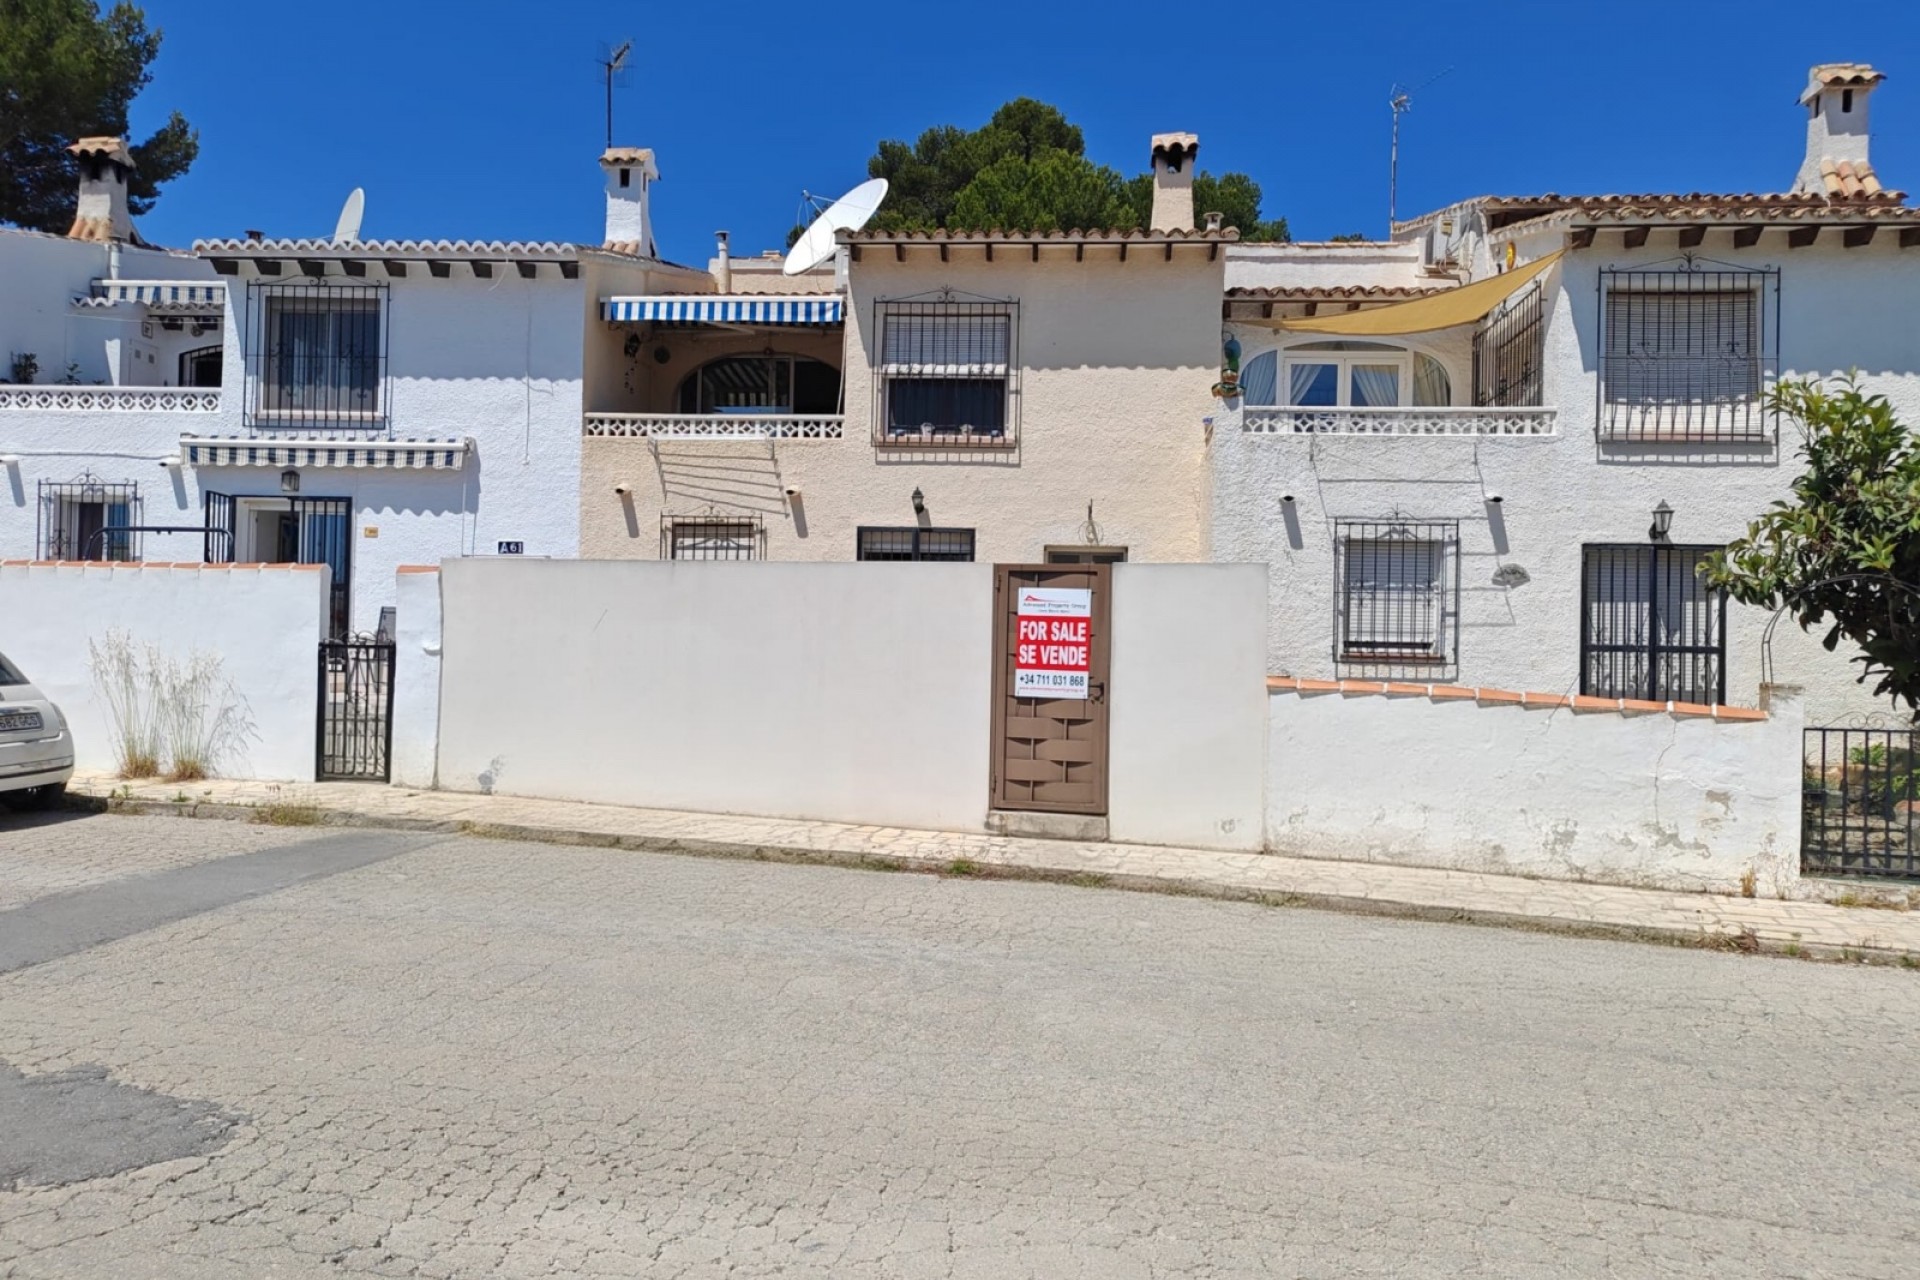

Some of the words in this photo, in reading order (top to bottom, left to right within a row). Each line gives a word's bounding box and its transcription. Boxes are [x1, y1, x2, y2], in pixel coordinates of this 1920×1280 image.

[500, 543, 522, 553] A61
[1020, 621, 1048, 640] FOR
[1051, 621, 1087, 642] SALE
[1019, 644, 1037, 664] SE
[1040, 645, 1087, 666] VENDE
[1020, 674, 1034, 684] +34
[1036, 674, 1050, 685] 711
[1052, 675, 1067, 686] 031
[1069, 676, 1085, 686] 868
